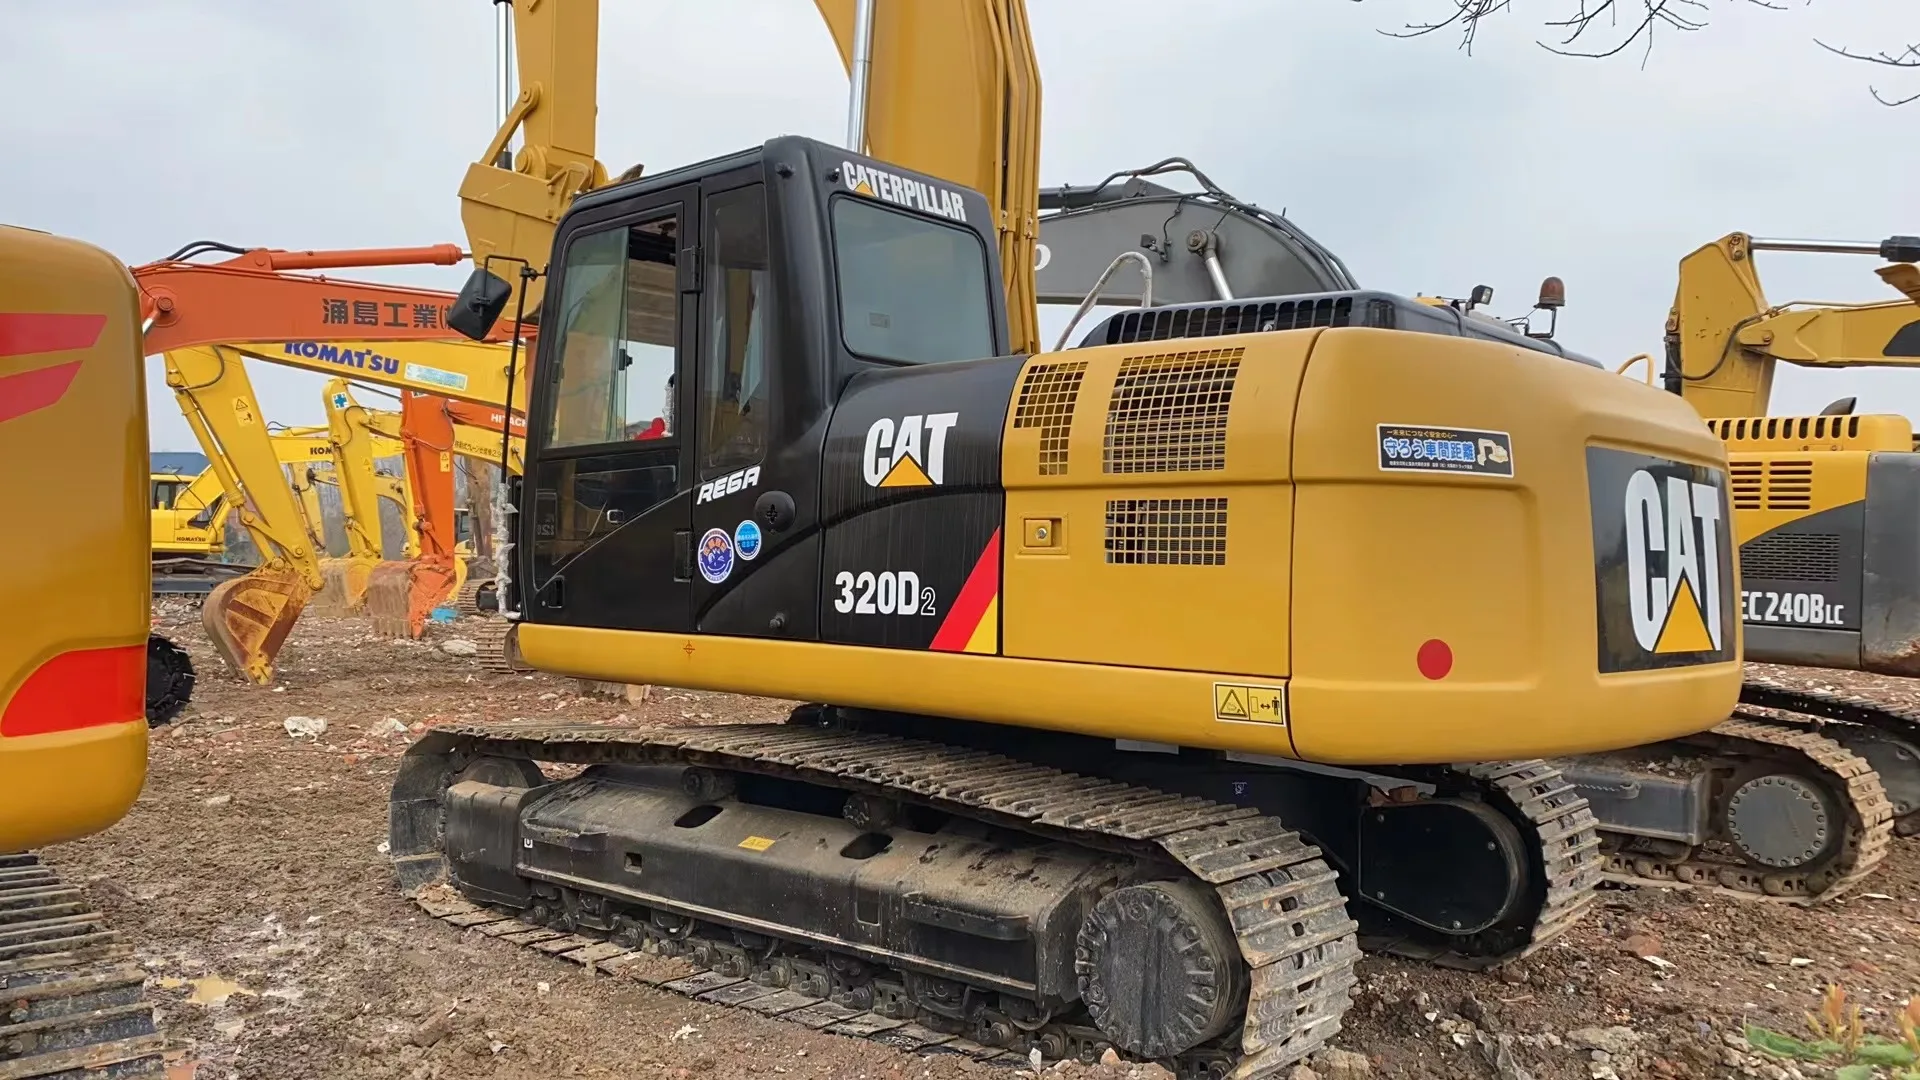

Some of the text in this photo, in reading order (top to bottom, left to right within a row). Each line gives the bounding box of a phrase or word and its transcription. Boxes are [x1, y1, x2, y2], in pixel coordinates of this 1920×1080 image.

[842, 160, 967, 222] CATERPILLAR
[322, 298, 453, 330] 涌島工業(
[284, 341, 400, 375] KOMATSU
[863, 411, 959, 488] CAT
[1383, 437, 1476, 463] 守ろう車間距離
[696, 465, 761, 506] REGA
[1625, 469, 1722, 652] CAT
